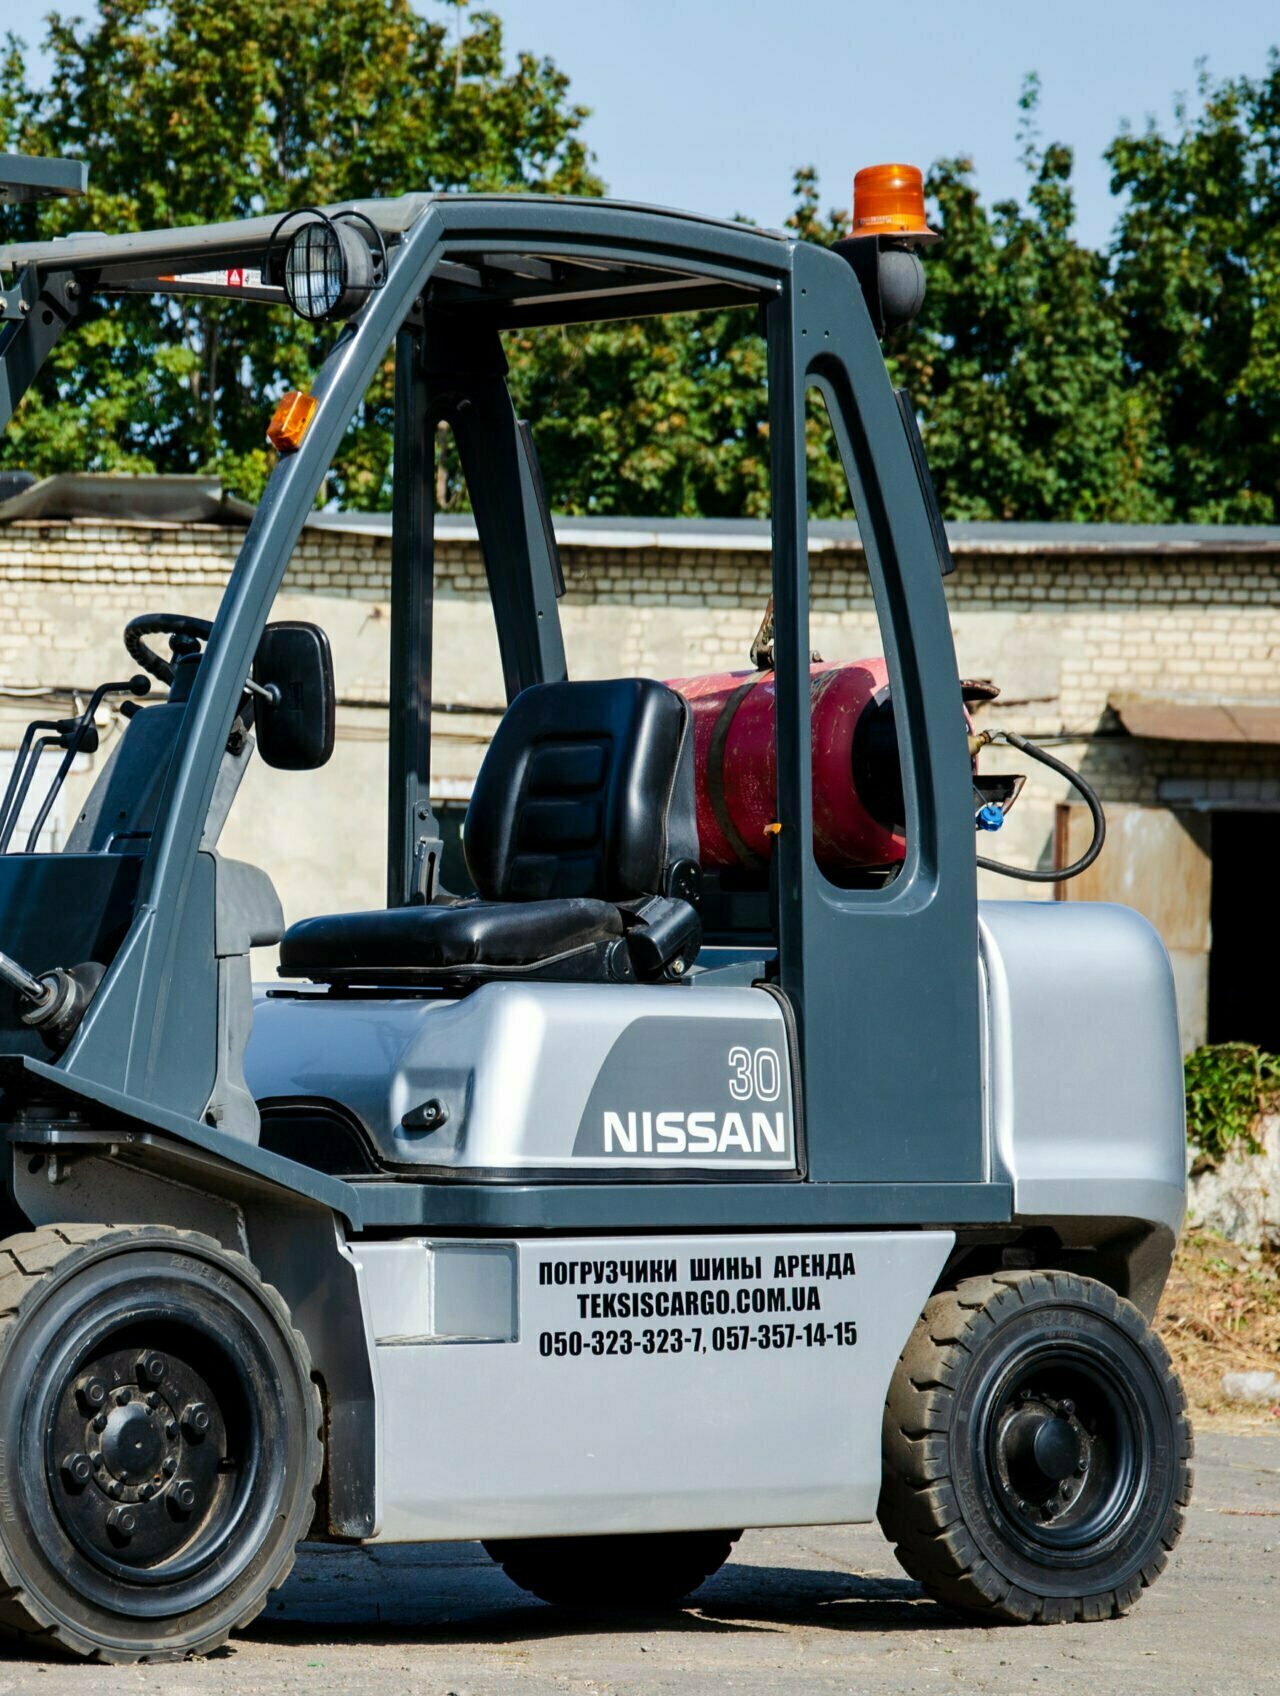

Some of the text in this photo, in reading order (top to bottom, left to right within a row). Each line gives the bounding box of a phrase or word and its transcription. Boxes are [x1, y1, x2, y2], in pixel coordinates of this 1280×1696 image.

[728, 1046, 781, 1102] 30
[603, 1111, 786, 1153] NISSAN
[539, 1252, 856, 1286] ПОГРУЗЧИКИ ШИНЫ АРЕНДА
[577, 1286, 821, 1319] TEKSISCARGO.COM.UA
[539, 1321, 858, 1357] 050-323-323-7, 057-357-14-15
